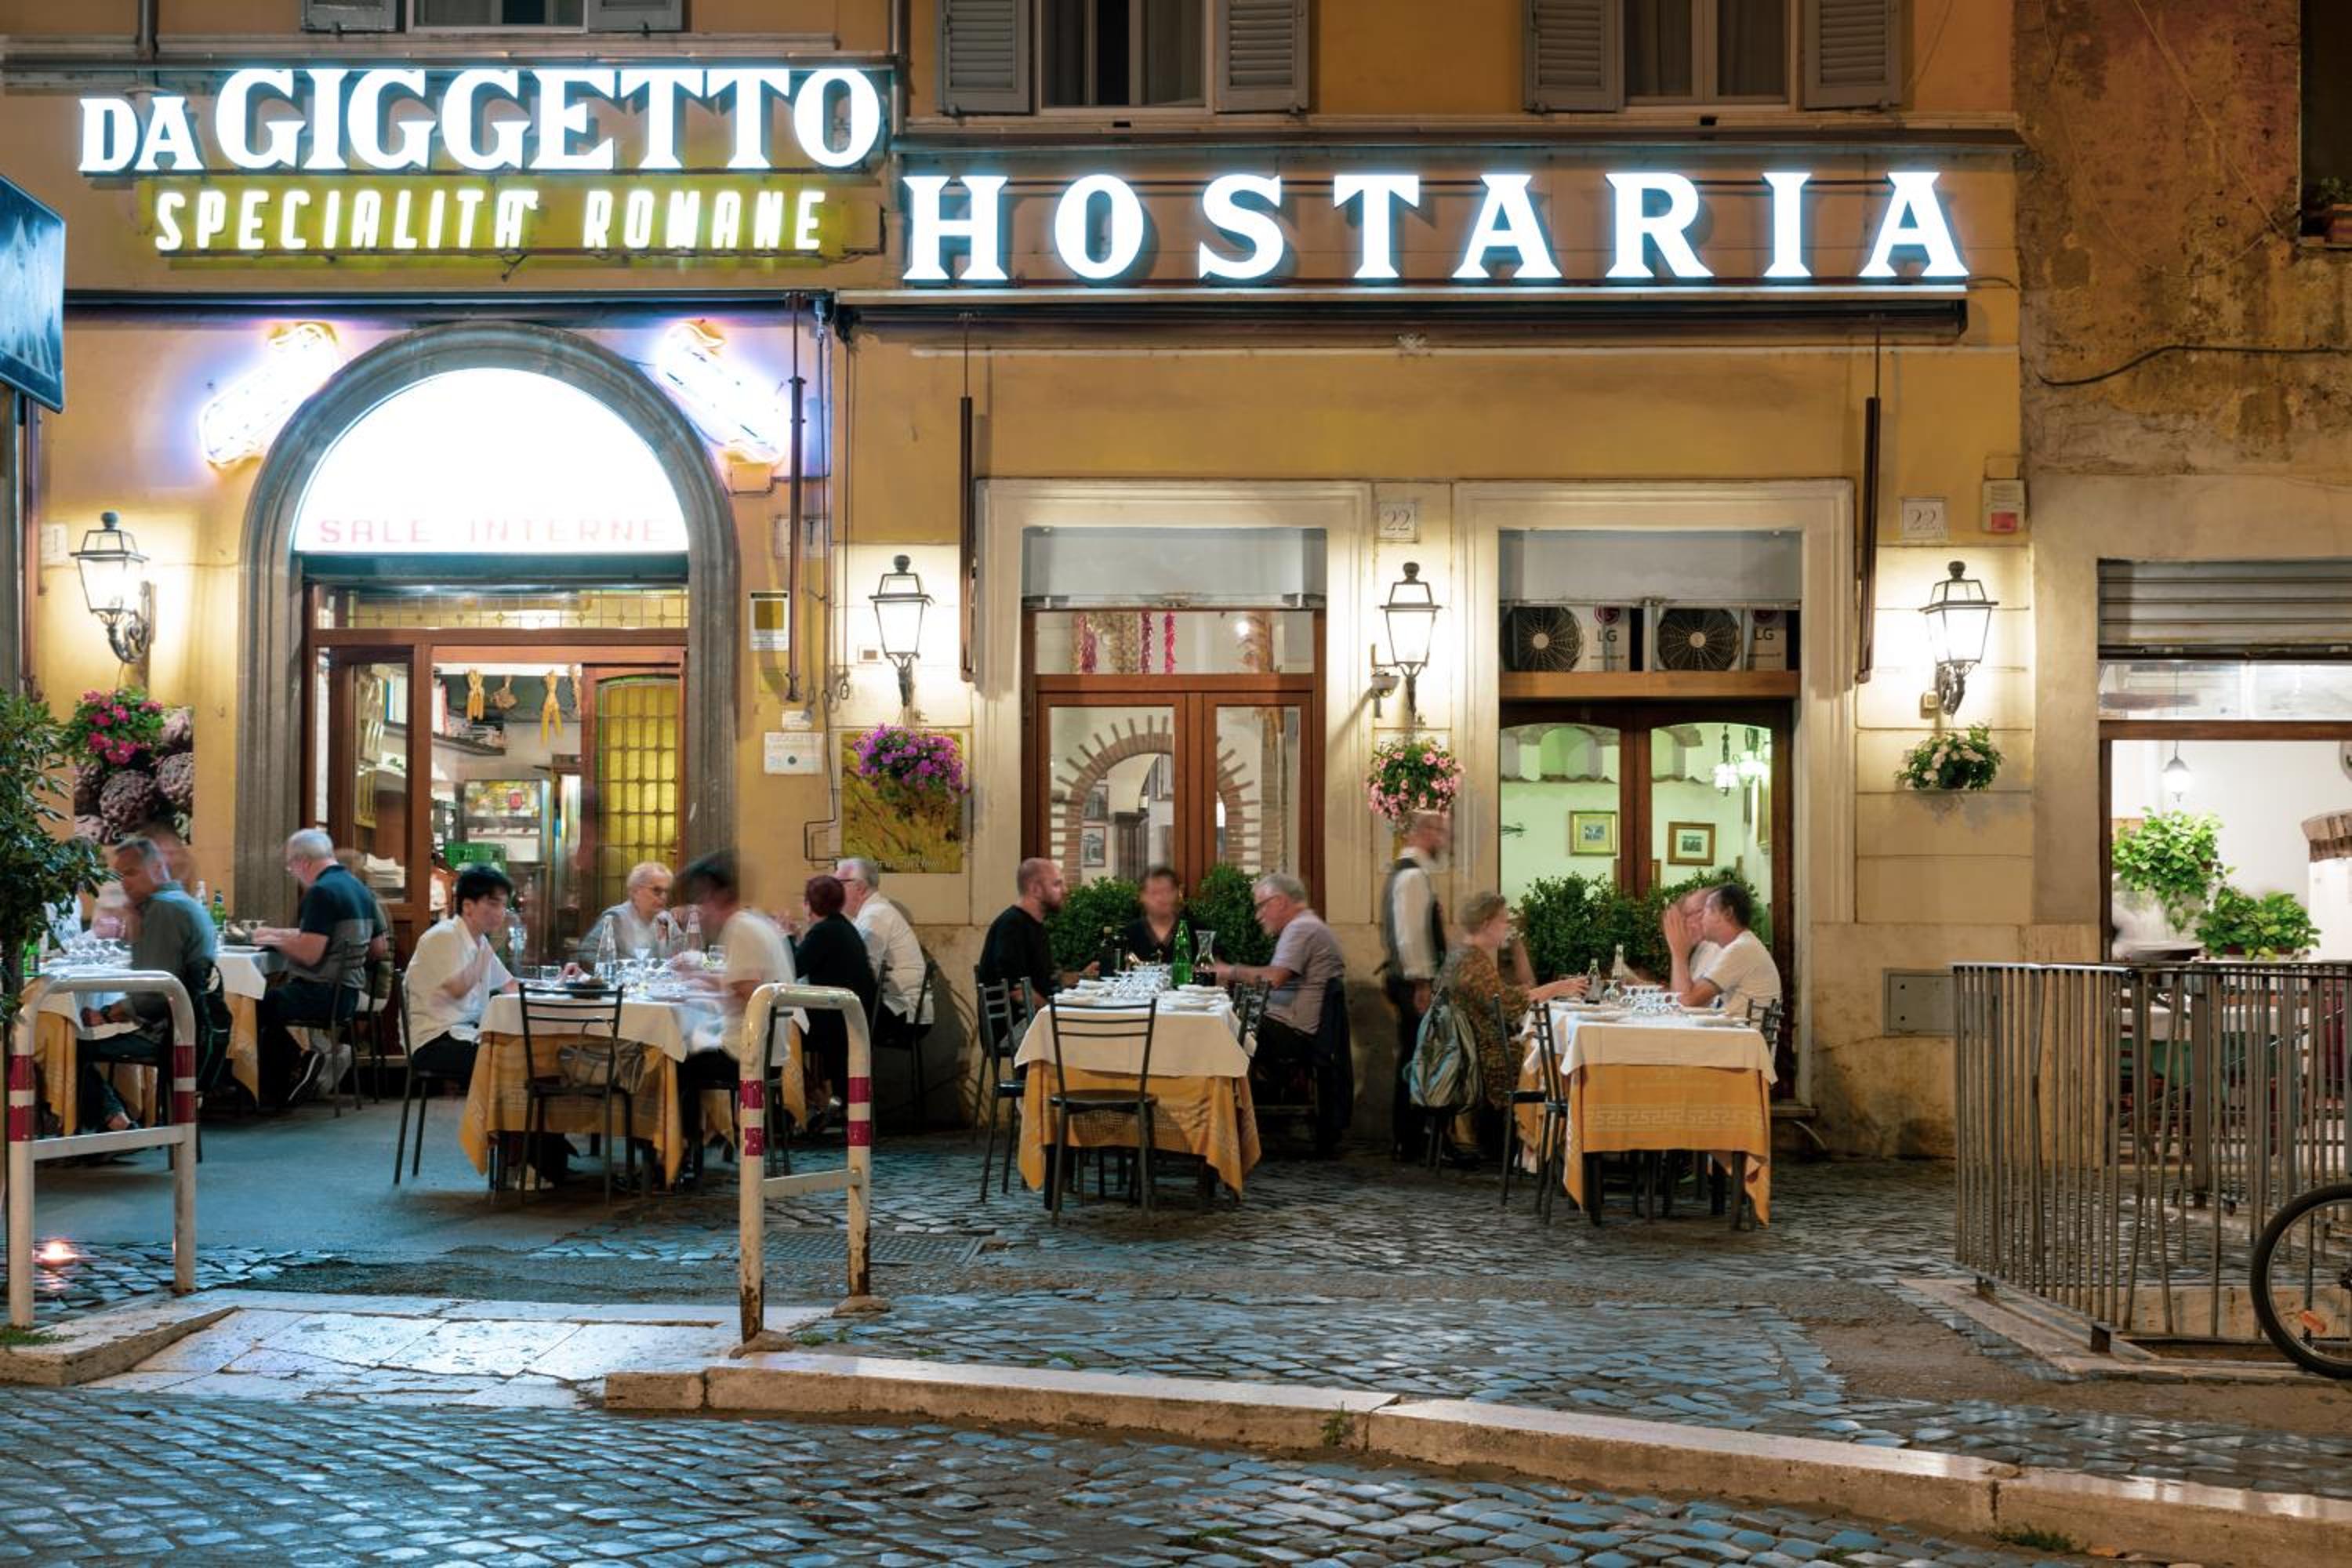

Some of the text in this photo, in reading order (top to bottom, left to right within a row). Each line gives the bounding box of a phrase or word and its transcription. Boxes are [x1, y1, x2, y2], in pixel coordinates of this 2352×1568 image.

[78, 68, 880, 172] DA GIGGETTO
[583, 189, 826, 250] ROMANE
[902, 172, 1969, 280] HOSTARIA
[318, 517, 666, 543] SALE INTERNE
[1384, 510, 1410, 531] 22
[1597, 630, 1618, 642] LG
[1753, 627, 1775, 641] LG
